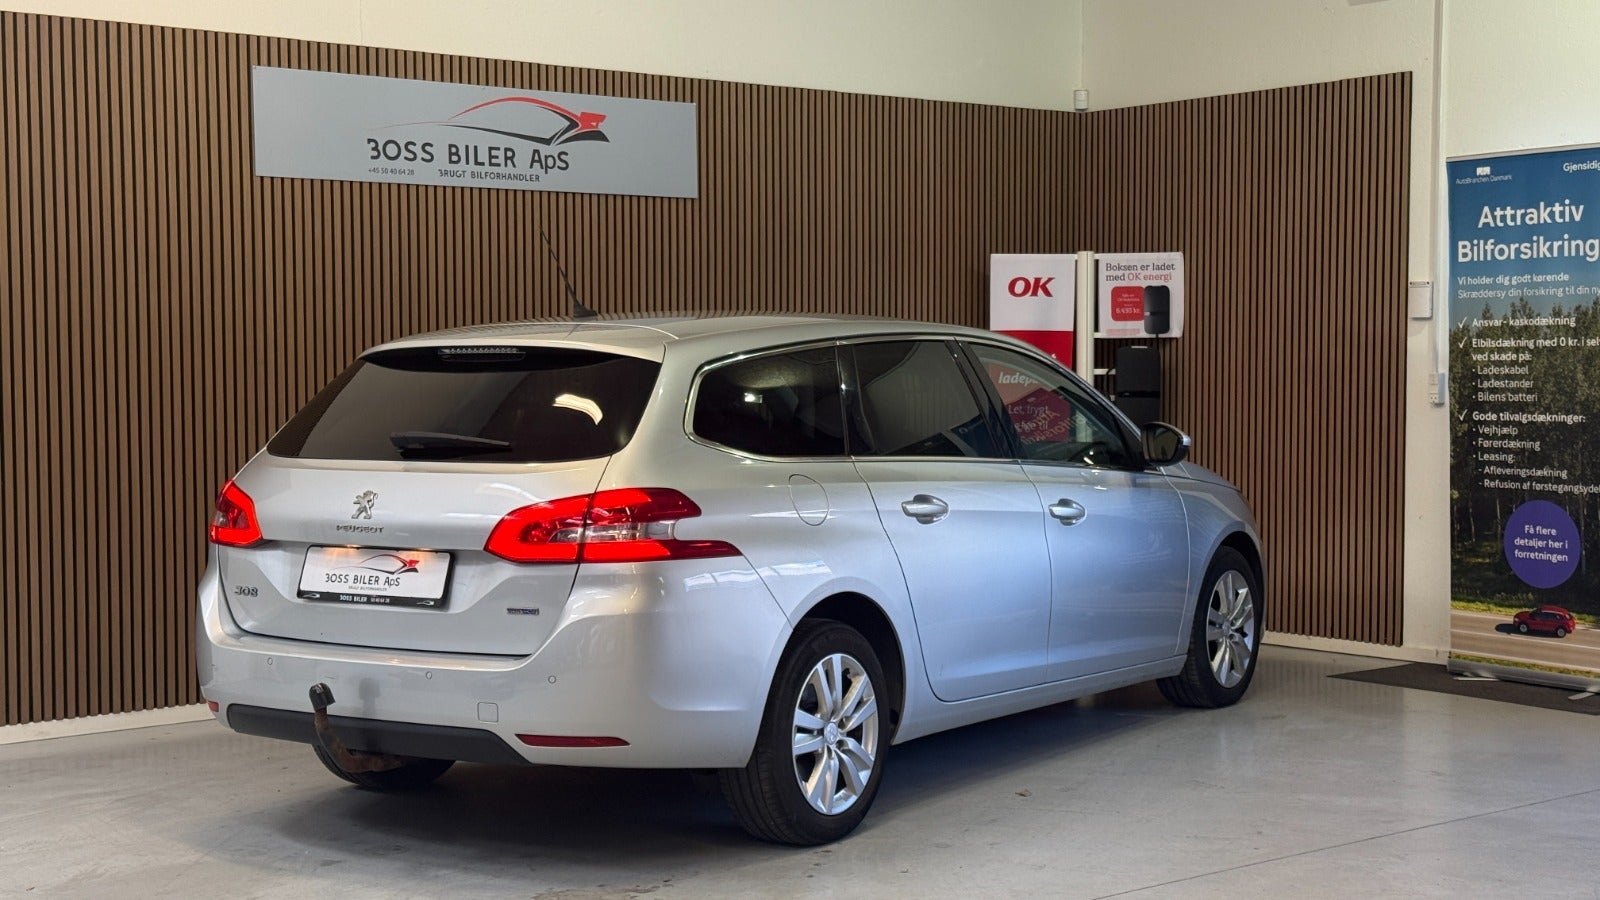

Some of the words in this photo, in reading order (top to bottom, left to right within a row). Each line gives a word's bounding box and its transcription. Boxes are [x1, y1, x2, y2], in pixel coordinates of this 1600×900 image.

[447, 143, 516, 169] BILER
[529, 148, 570, 174] ApS
[470, 170, 540, 182] BILFORHANDLER
[1477, 199, 1584, 228] Attraktiv
[1457, 233, 1600, 263] Bilforsikring
[1105, 263, 1138, 272] Boksen
[1152, 263, 1176, 271] ladet
[1105, 273, 1125, 282] med
[1127, 273, 1142, 281] OK
[1143, 273, 1172, 283] energi
[1457, 276, 1466, 285] Vi
[1467, 276, 1494, 285] holder
[1495, 275, 1510, 285] dig
[1511, 274, 1532, 285] godt
[1533, 271, 1570, 282] kørende
[1008, 276, 1056, 298] OK
[1457, 288, 1506, 299] Skræddersy
[1507, 287, 1522, 297] din
[1523, 286, 1564, 297] forsikring
[1565, 285, 1575, 295] til
[1576, 284, 1590, 295] din
[1509, 315, 1576, 327] kaskodækning
[1472, 338, 1535, 349] Elbilsdækning
[1536, 338, 1558, 347] med
[1559, 337, 1566, 346] 0
[1568, 336, 1580, 346] kr.
[1472, 351, 1489, 361] ved
[1490, 352, 1518, 361] skade
[1519, 351, 1533, 363] på:
[1477, 365, 1529, 375] Ladeskabel
[1477, 379, 1534, 389] Ladestander
[1477, 392, 1507, 402] Bilens
[1508, 392, 1538, 402] batteri
[1472, 411, 1498, 421] Gode
[1499, 411, 1586, 425] tilvalgsdækninger:
[1477, 425, 1518, 436] Vejhjælp
[1477, 438, 1541, 452] Førerdækning
[1483, 465, 1568, 480] Afleveringsdækning
[1483, 479, 1521, 490] Refusion
[1522, 481, 1531, 490] af
[336, 525, 384, 534] PEUGEOT
[1525, 525, 1535, 534] Få
[1536, 526, 1557, 536] flere
[1514, 537, 1547, 549] detaljer
[1548, 540, 1563, 549] her
[1514, 549, 1568, 563] forretningen
[353, 574, 380, 586] BILER
[383, 576, 400, 588] ApS
[234, 586, 259, 597] 308
